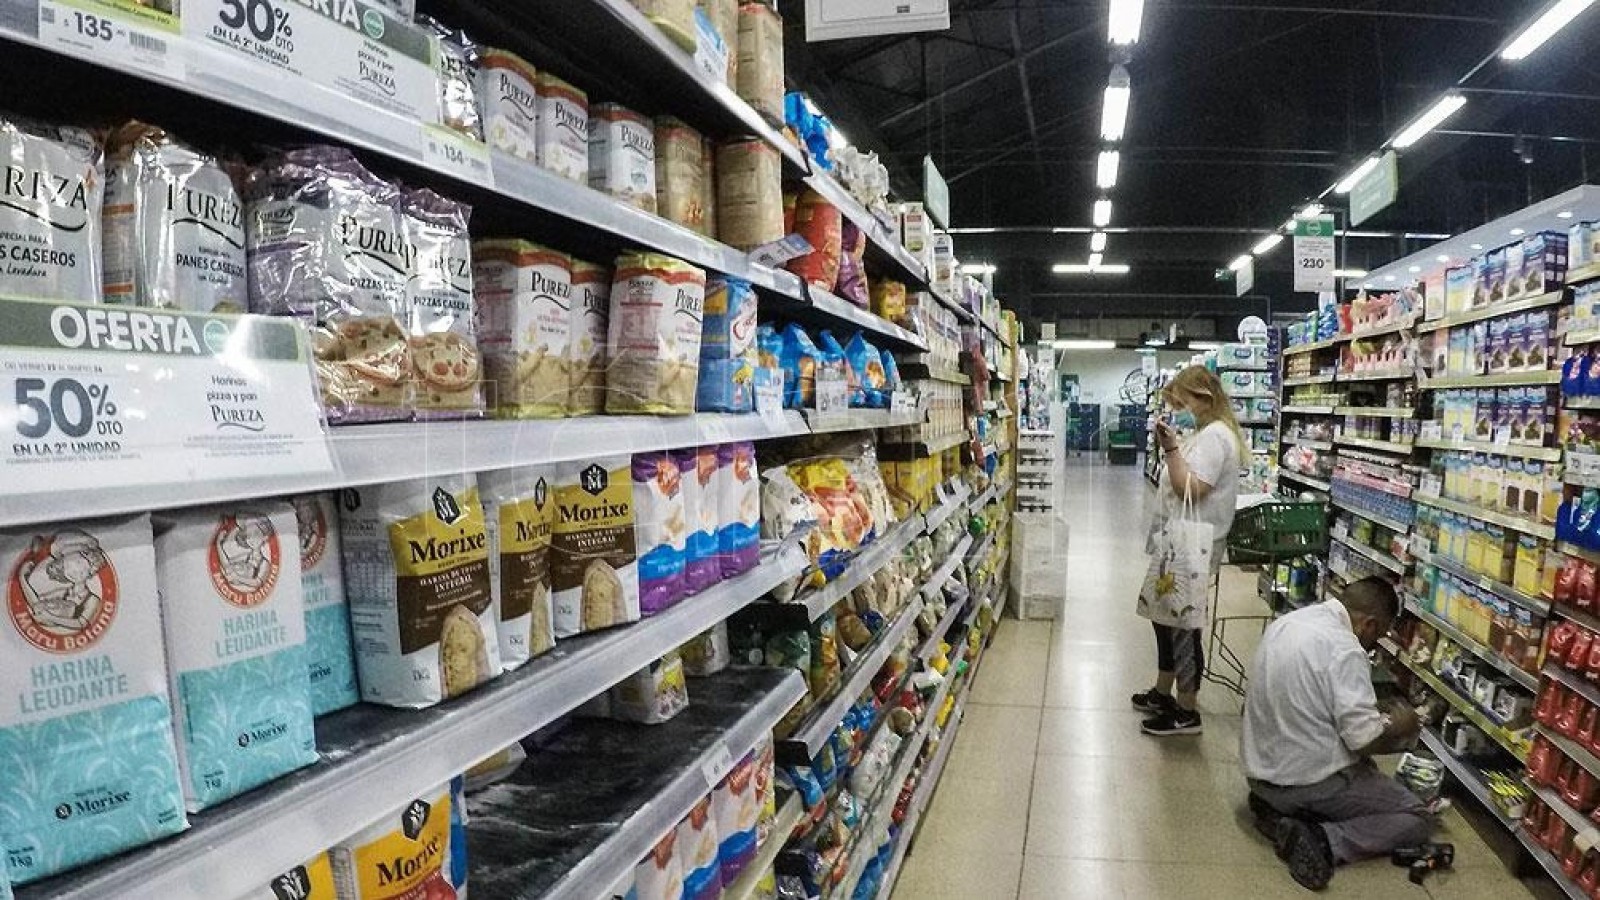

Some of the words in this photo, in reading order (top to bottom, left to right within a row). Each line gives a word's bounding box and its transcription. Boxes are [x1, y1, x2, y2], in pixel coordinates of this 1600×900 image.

[74, 11, 113, 41] 135
[10, 245, 76, 268] CASEROS
[50, 305, 201, 354] OFERTA
[209, 404, 265, 422] PUREZA
[96, 420, 124, 435] DTO
[13, 443, 31, 455] EN
[34, 442, 52, 456] LA
[70, 441, 122, 455] UNIDAD
[558, 498, 630, 524] Morixe
[408, 528, 486, 564] Morixe
[223, 609, 279, 635] HARINA
[214, 626, 288, 657] LEUDANTE
[30, 654, 115, 688] HARINA
[18, 674, 129, 714] LEUDANTE
[75, 790, 131, 817] Morixe
